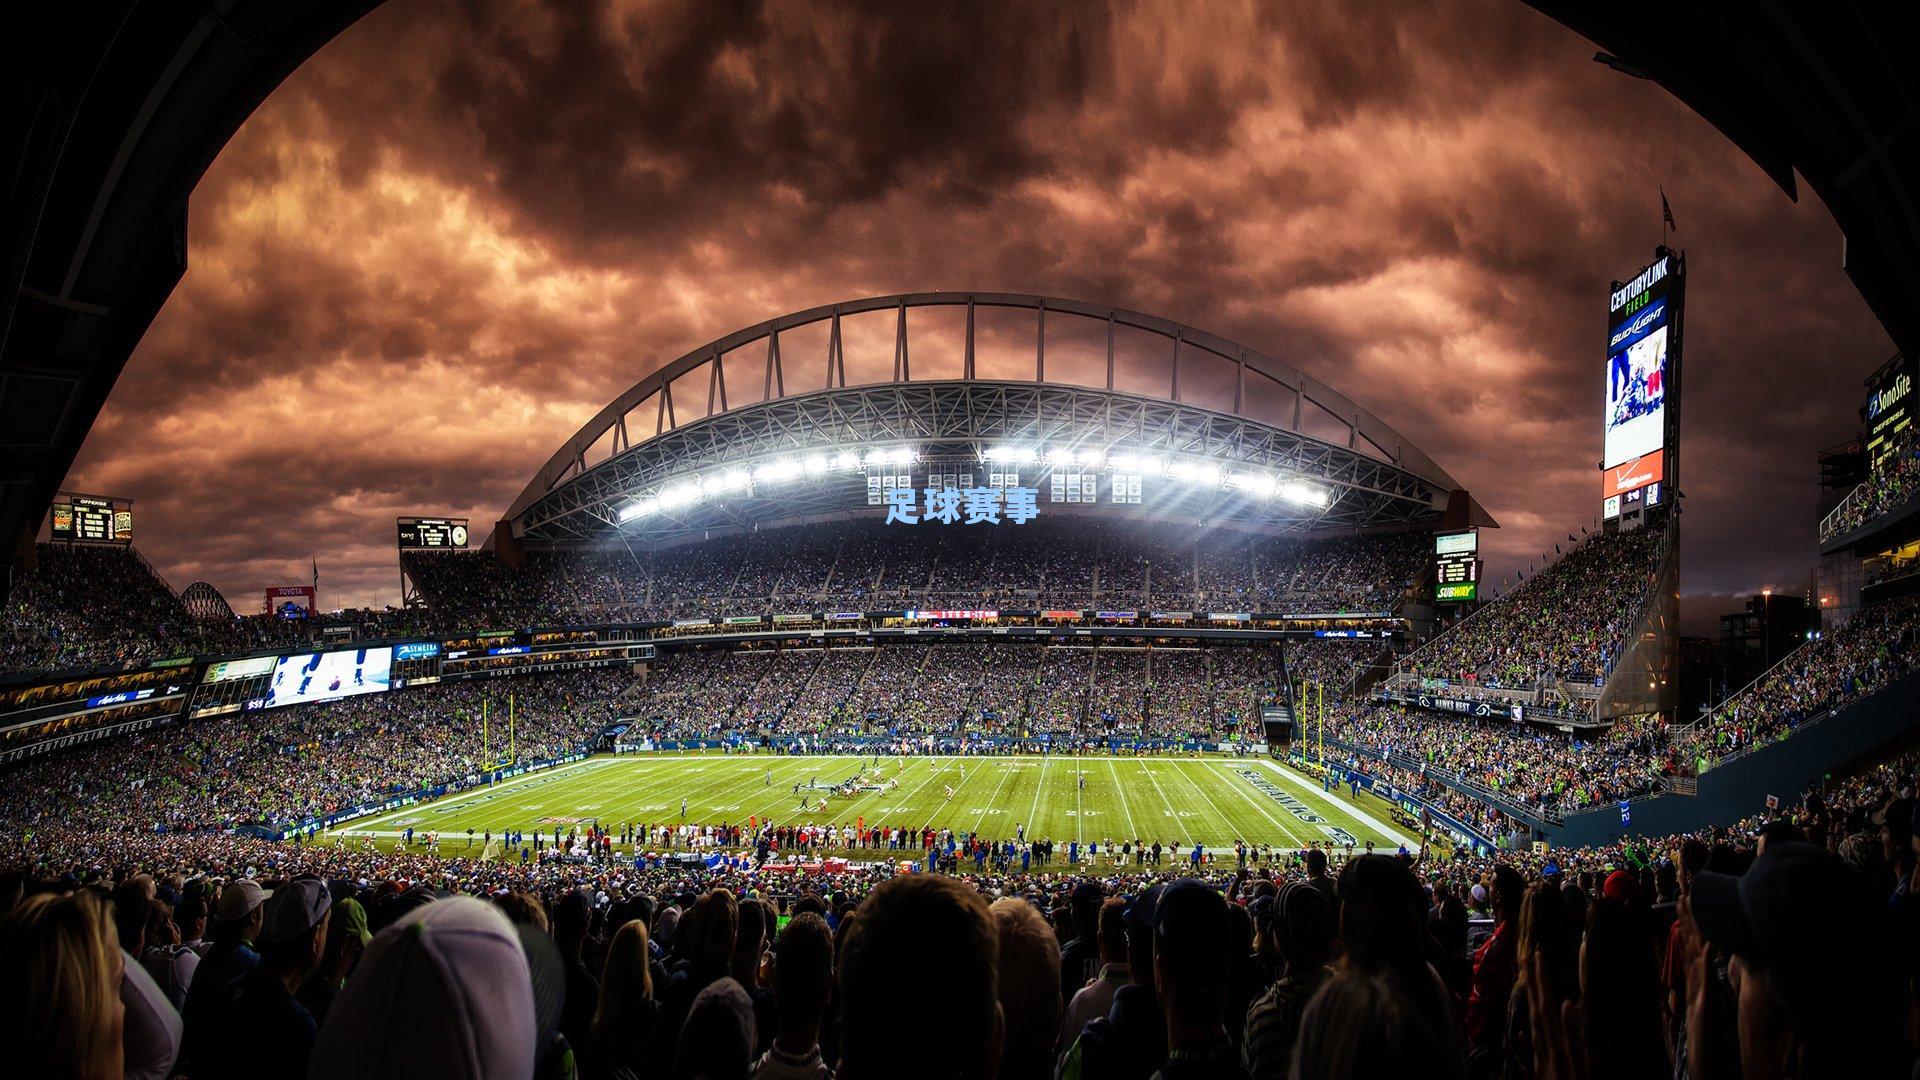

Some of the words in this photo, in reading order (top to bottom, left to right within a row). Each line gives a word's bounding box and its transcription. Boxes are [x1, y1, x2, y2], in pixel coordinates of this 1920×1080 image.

[1610, 256, 1669, 313] CENTURYLINK
[1625, 290, 1650, 316] FIELD
[1610, 327, 1632, 347] BUD
[1632, 305, 1665, 333] LIGHT
[1878, 373, 1912, 415] SonoSite
[401, 532, 415, 540] bing
[278, 587, 304, 596] TOYOTA
[1437, 585, 1475, 599] SUBWAY
[410, 643, 438, 653] SYMETRA
[589, 660, 609, 668] MAN
[10, 749, 24, 761] TO
[30, 728, 112, 756] CENTURYLINK
[118, 720, 153, 735] FIELD
[1620, 806, 1630, 823] 12
